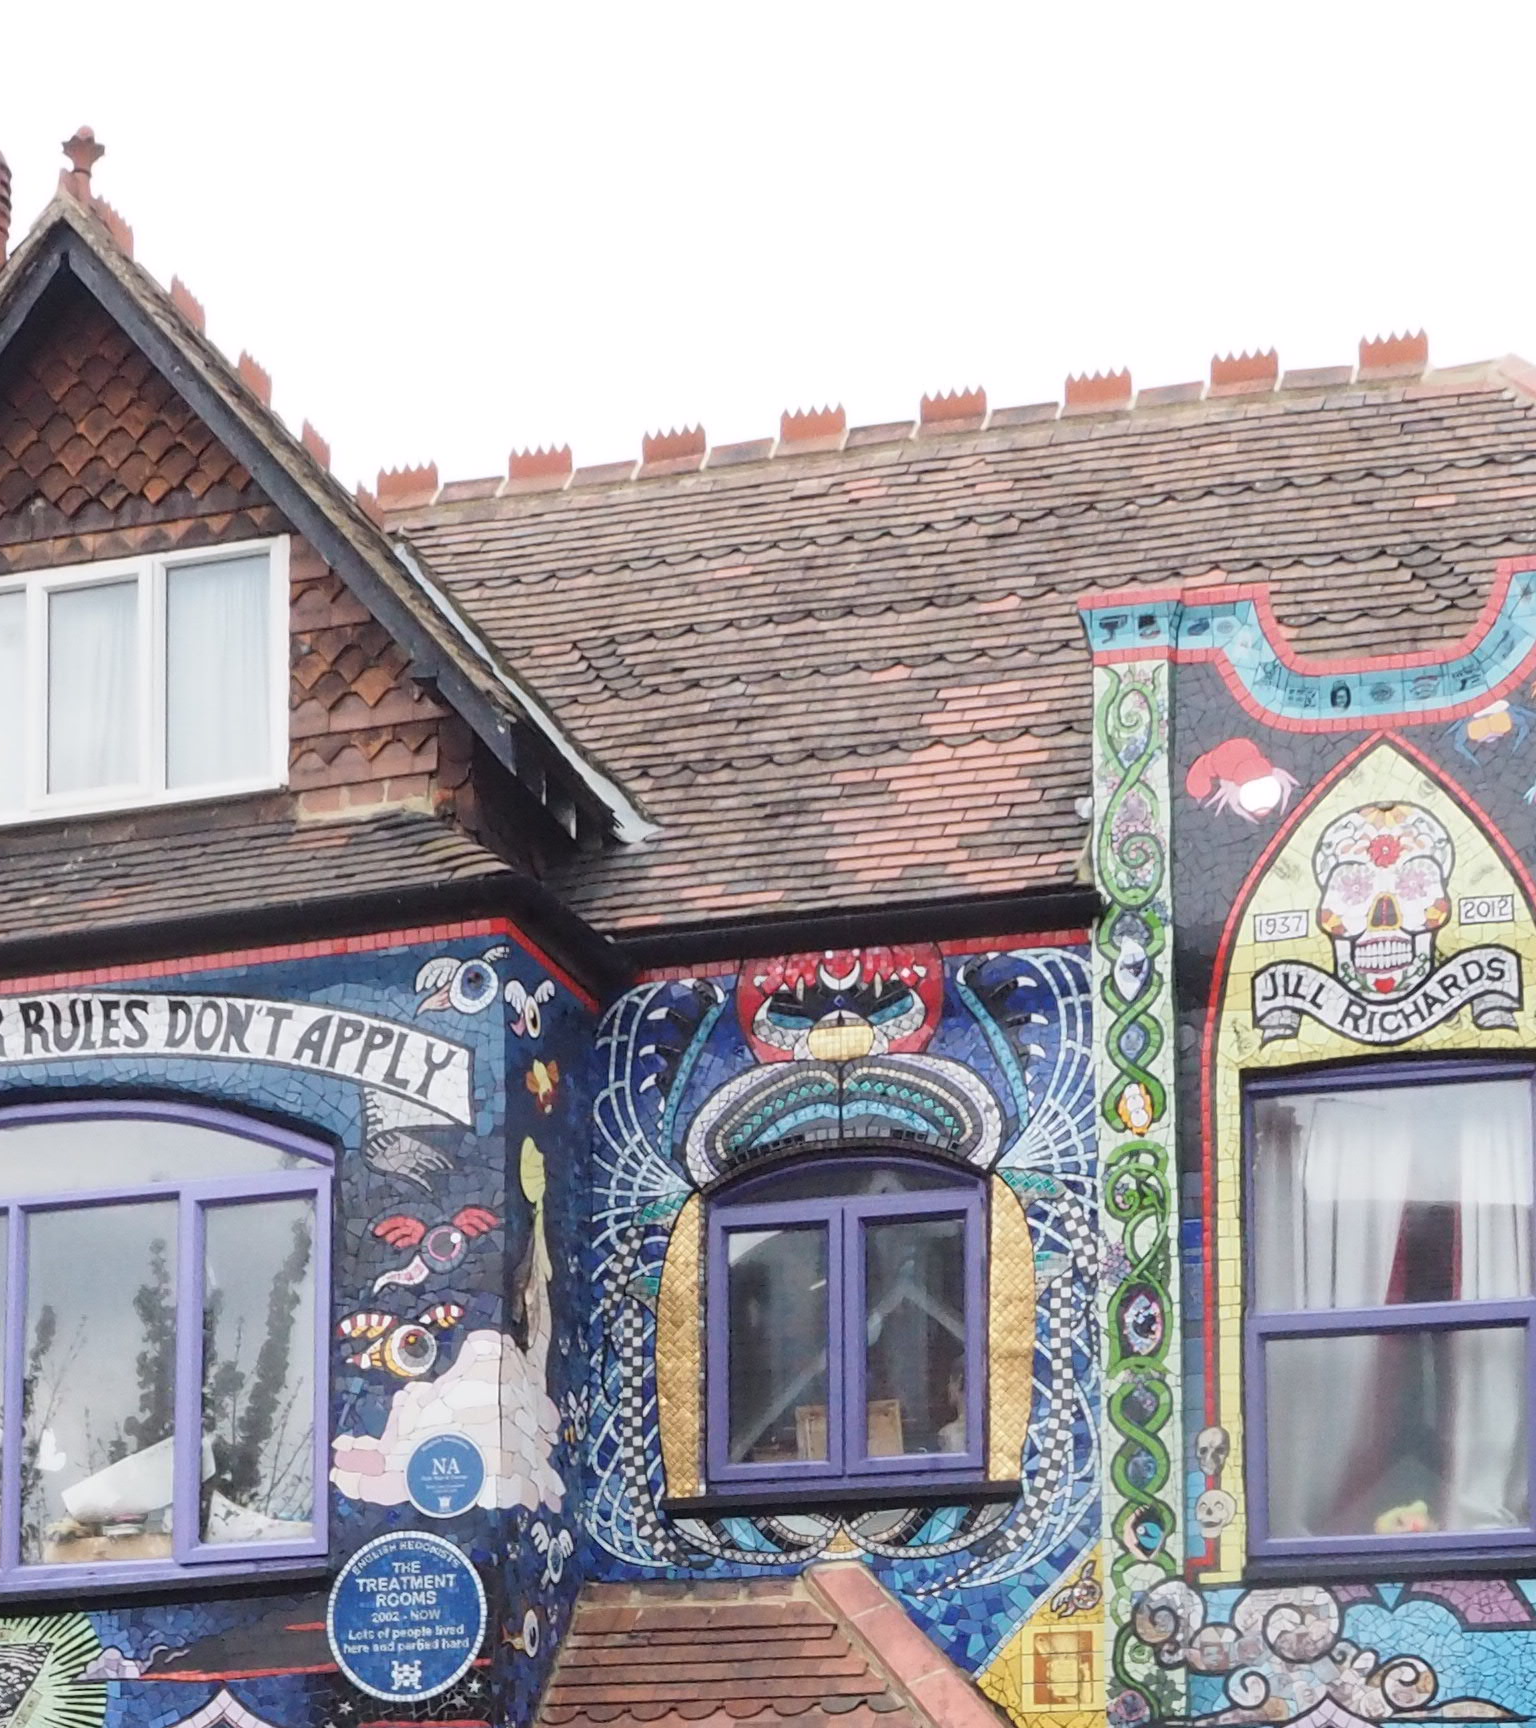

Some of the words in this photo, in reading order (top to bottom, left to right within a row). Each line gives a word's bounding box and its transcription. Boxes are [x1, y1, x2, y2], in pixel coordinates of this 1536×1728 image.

[1464, 896, 1512, 920] 2012
[1259, 916, 1302, 935] 1937
[1261, 971, 1326, 1011] JILL
[1338, 956, 1508, 1035] RICHARDS
[19, 999, 150, 1055] RULES
[165, 999, 295, 1058] DON'T
[294, 1014, 457, 1100] APPLY
[432, 1458, 460, 1475] NA
[352, 1544, 397, 1576] ENGLISH
[400, 1540, 462, 1569] HEDONISTS
[392, 1561, 421, 1574] THE
[355, 1574, 457, 1592] TREATMENT
[375, 1591, 438, 1608] ROOMS
[371, 1612, 401, 1624] 2002
[410, 1610, 441, 1621] NOW
[348, 1630, 375, 1641] Lots
[378, 1628, 390, 1639] of
[392, 1627, 432, 1641] people
[435, 1624, 464, 1636] lived
[343, 1643, 369, 1654] here
[373, 1640, 395, 1652] and
[442, 1638, 470, 1649] hard
